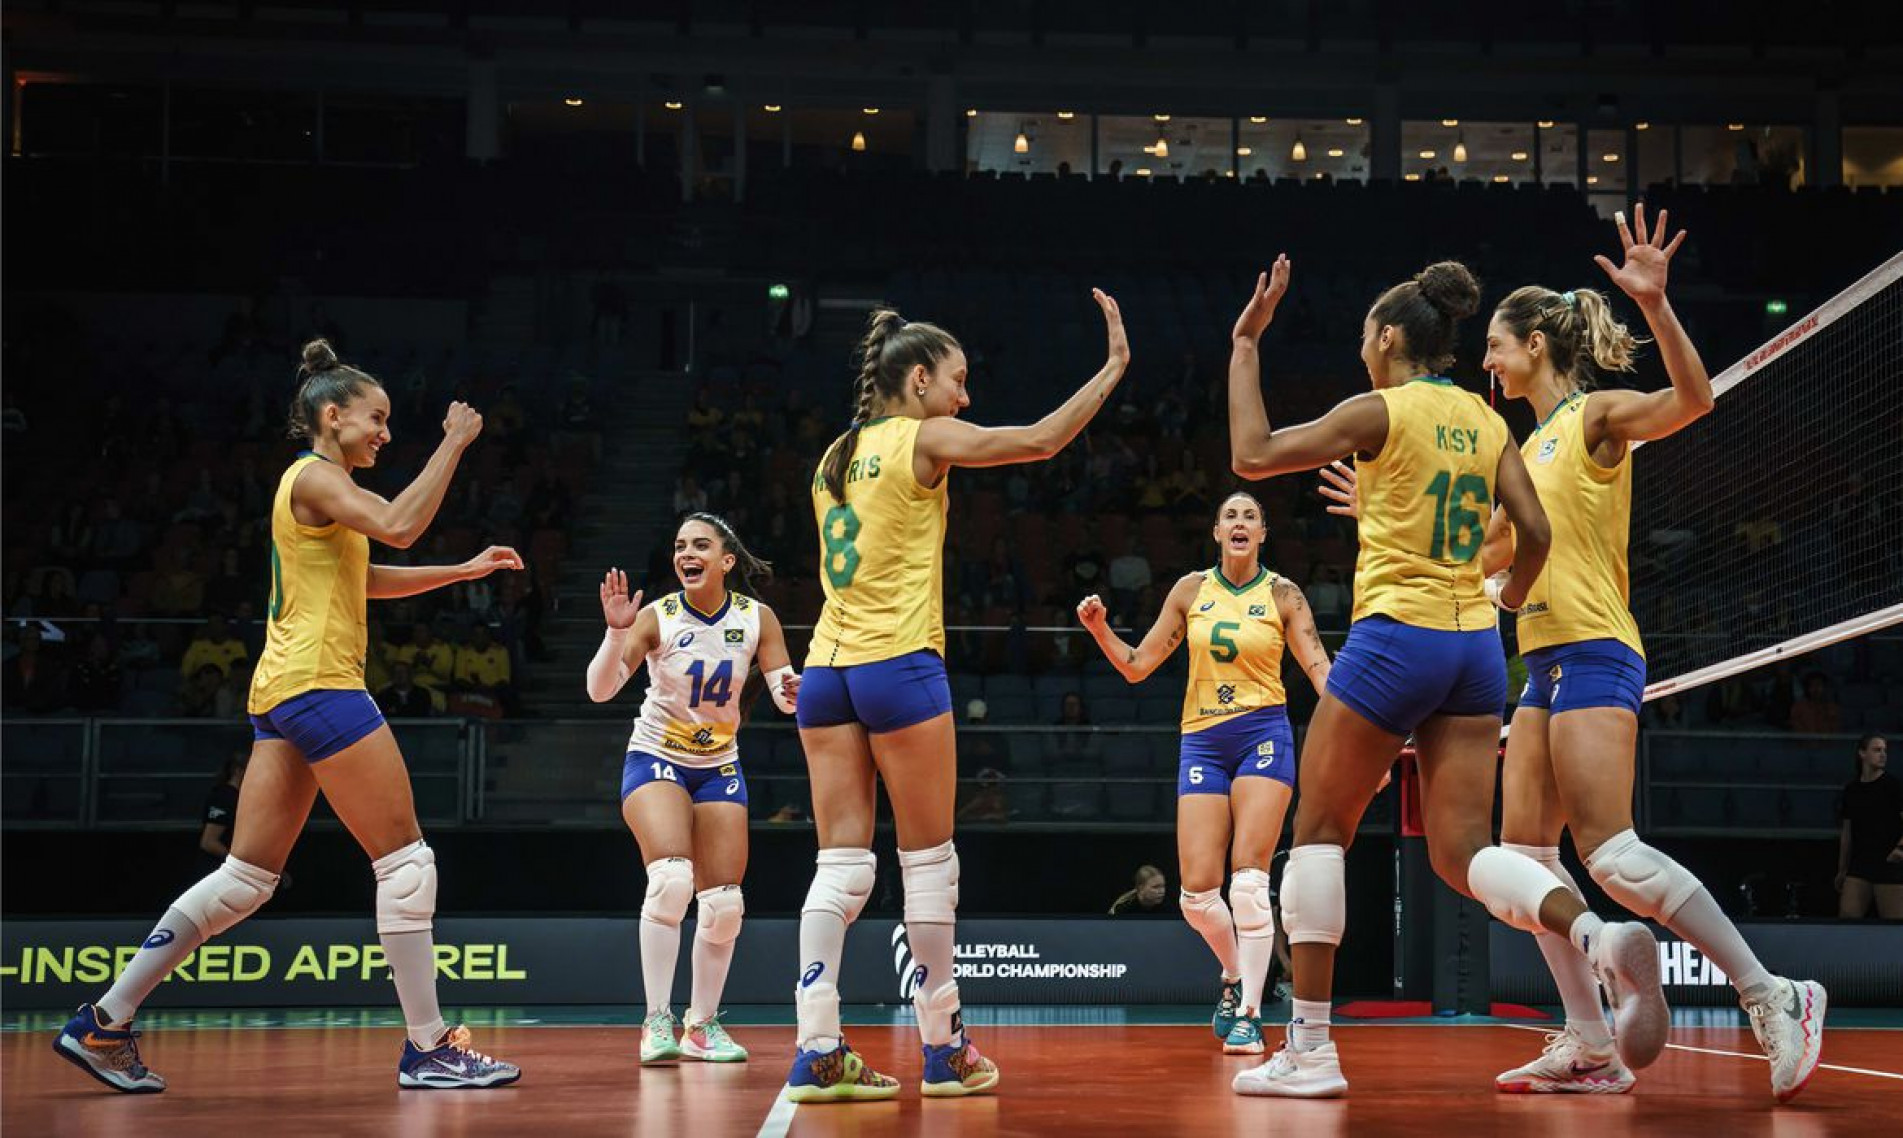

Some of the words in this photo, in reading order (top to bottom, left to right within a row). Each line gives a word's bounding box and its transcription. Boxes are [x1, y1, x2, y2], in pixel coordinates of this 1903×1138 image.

[814, 454, 881, 494] MRIS
[1424, 470, 1489, 563] 16
[823, 503, 862, 588] 8
[1210, 620, 1240, 663] 5
[685, 659, 733, 708] 14
[651, 762, 677, 781] 14
[1189, 766, 1204, 785] 5
[0, 945, 272, 984] -INSPRED
[284, 944, 527, 981] APPREL
[953, 944, 1040, 958] LLEYBALL
[953, 963, 995, 978] ORLD
[997, 963, 1127, 978] CHAMPIONSHIP
